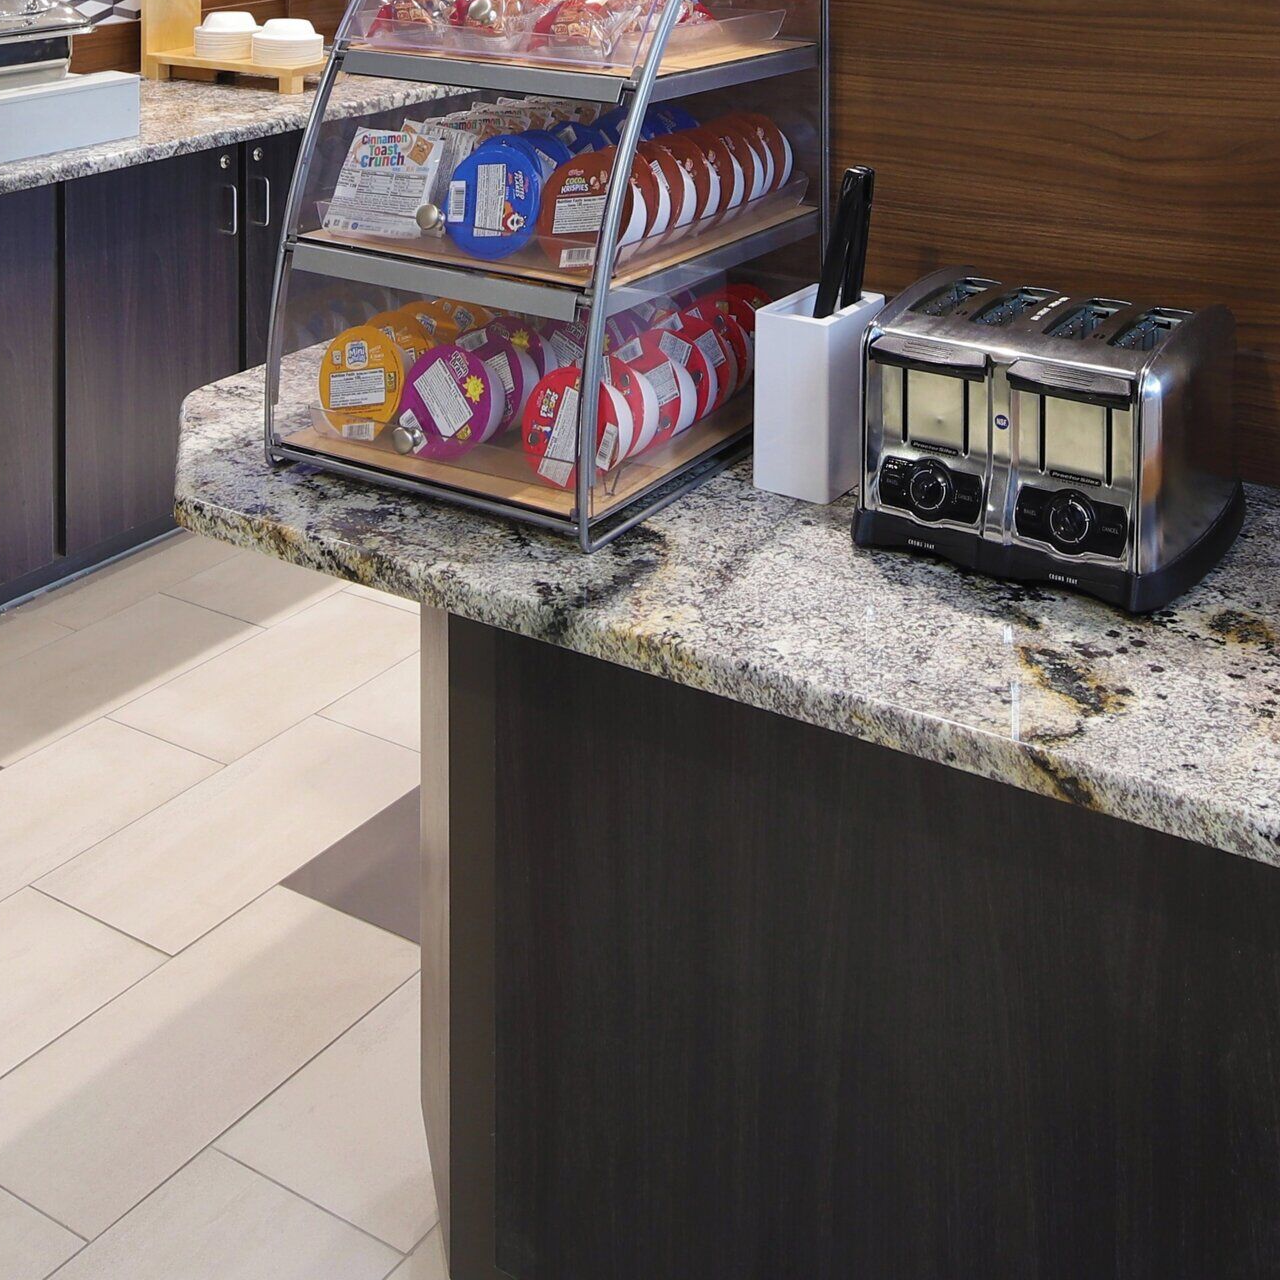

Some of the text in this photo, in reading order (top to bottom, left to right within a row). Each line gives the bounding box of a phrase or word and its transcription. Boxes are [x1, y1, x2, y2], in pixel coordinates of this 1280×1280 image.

[361, 133, 408, 145] Cinnamon
[368, 144, 399, 157] Toast
[360, 151, 405, 168] Crunch
